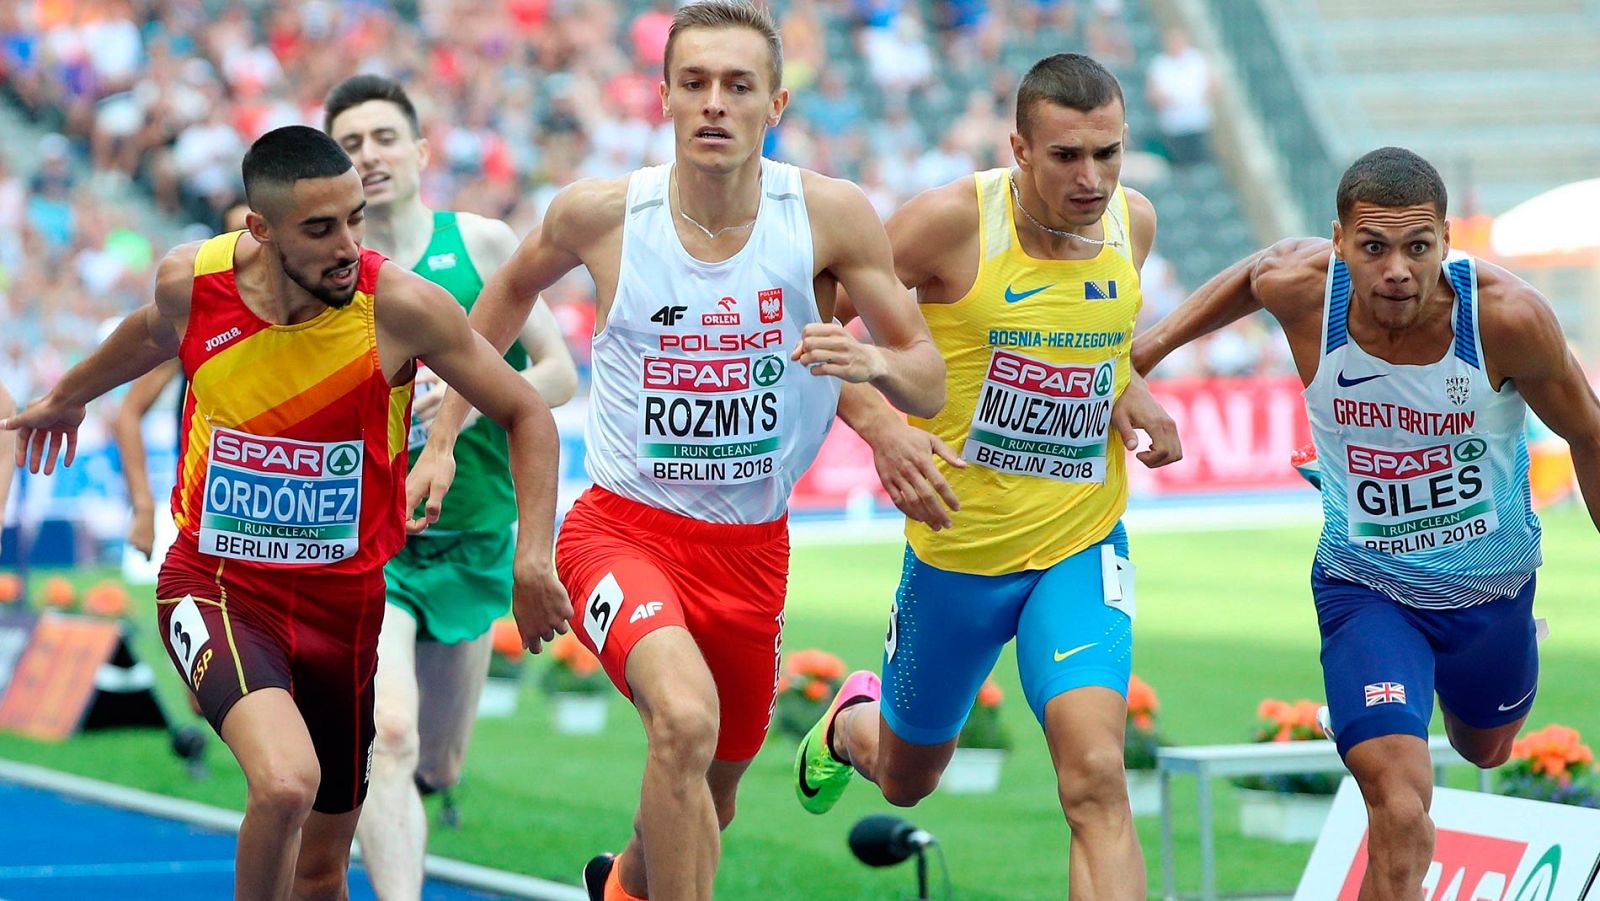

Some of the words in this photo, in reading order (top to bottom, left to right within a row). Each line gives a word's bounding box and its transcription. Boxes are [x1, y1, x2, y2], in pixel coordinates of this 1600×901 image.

[650, 305, 688, 326] 4F
[704, 315, 738, 325] ORLEN
[659, 328, 783, 352] POLSKA
[988, 329, 1126, 348] BOSNIA-HERZEGOVIN
[646, 361, 748, 388] SPAR
[993, 357, 1092, 393] SPAR
[644, 391, 778, 438] ROZMYS
[978, 385, 1110, 439] MUJEZINOVIC
[1333, 397, 1395, 428] GREAT
[1398, 406, 1475, 436] BRITAIN
[216, 435, 321, 473] SPAR
[673, 446, 677, 456] I
[681, 446, 710, 457] RUN
[1001, 437, 1005, 447] I
[1008, 440, 1035, 452] RUN
[653, 461, 726, 481] BERLIN
[732, 457, 773, 480] 2018
[976, 446, 1046, 473] BERLIN
[1050, 460, 1093, 479] 2018
[1350, 449, 1449, 476] SPAR
[210, 475, 356, 523] ORDÓÑEZ
[1356, 464, 1483, 517] GILES
[237, 521, 241, 532] I
[244, 523, 273, 536] RUN
[1382, 527, 1386, 536] I
[1390, 522, 1417, 536] RUN
[1442, 518, 1488, 545] 2018
[215, 534, 289, 560] BERLIN
[295, 543, 345, 560] 2018
[589, 593, 611, 632] 5
[174, 620, 192, 663] 3
[193, 648, 213, 691] ESP
